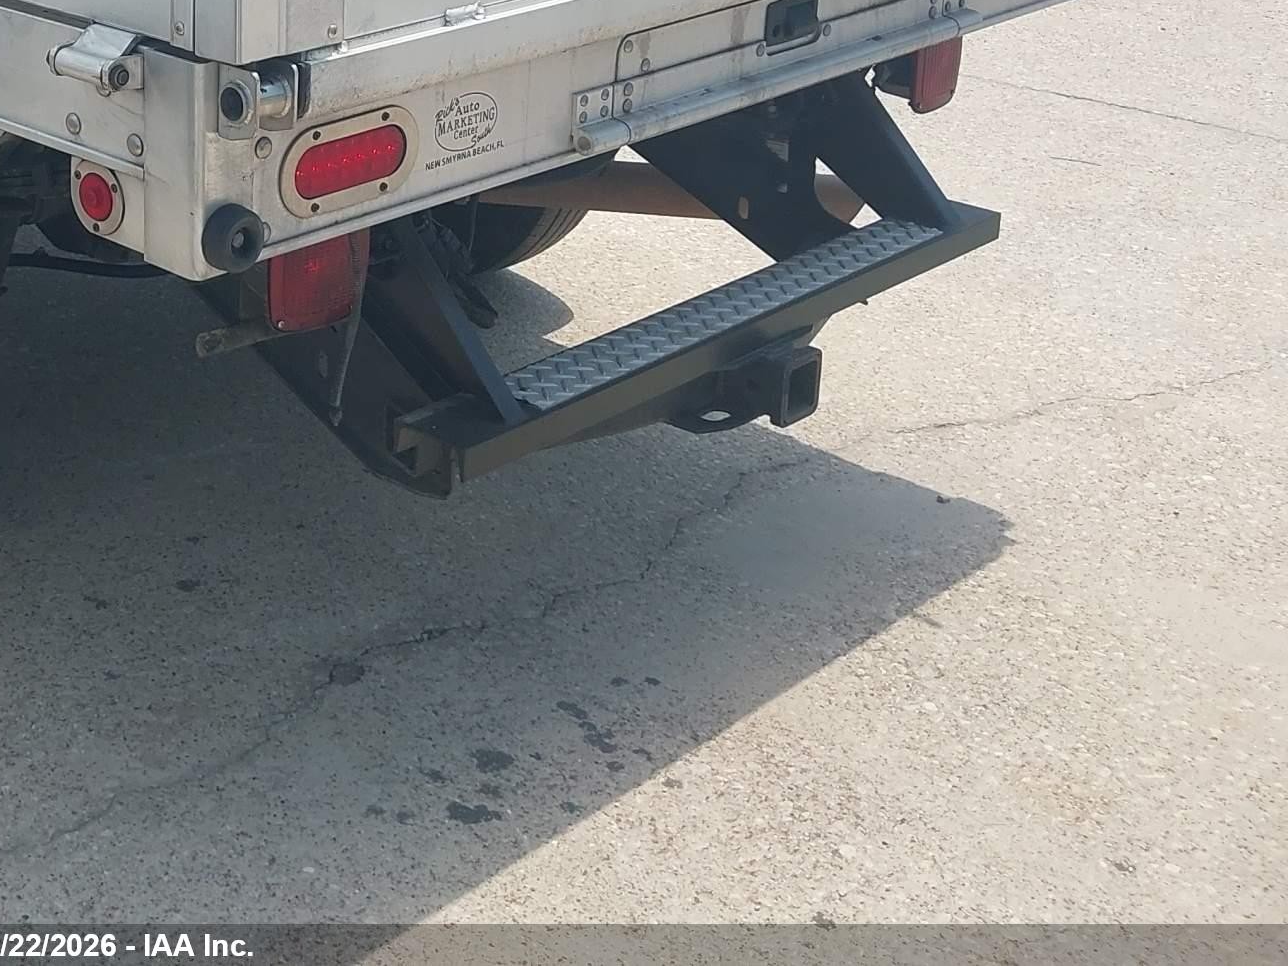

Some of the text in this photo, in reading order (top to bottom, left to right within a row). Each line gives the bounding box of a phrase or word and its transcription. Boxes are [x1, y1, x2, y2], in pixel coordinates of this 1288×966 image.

[455, 102, 480, 116] Auto
[438, 107, 495, 137] MARKETING
[453, 126, 479, 140] Center
[425, 160, 441, 170] NEW
[441, 150, 472, 166] SMYRNA
